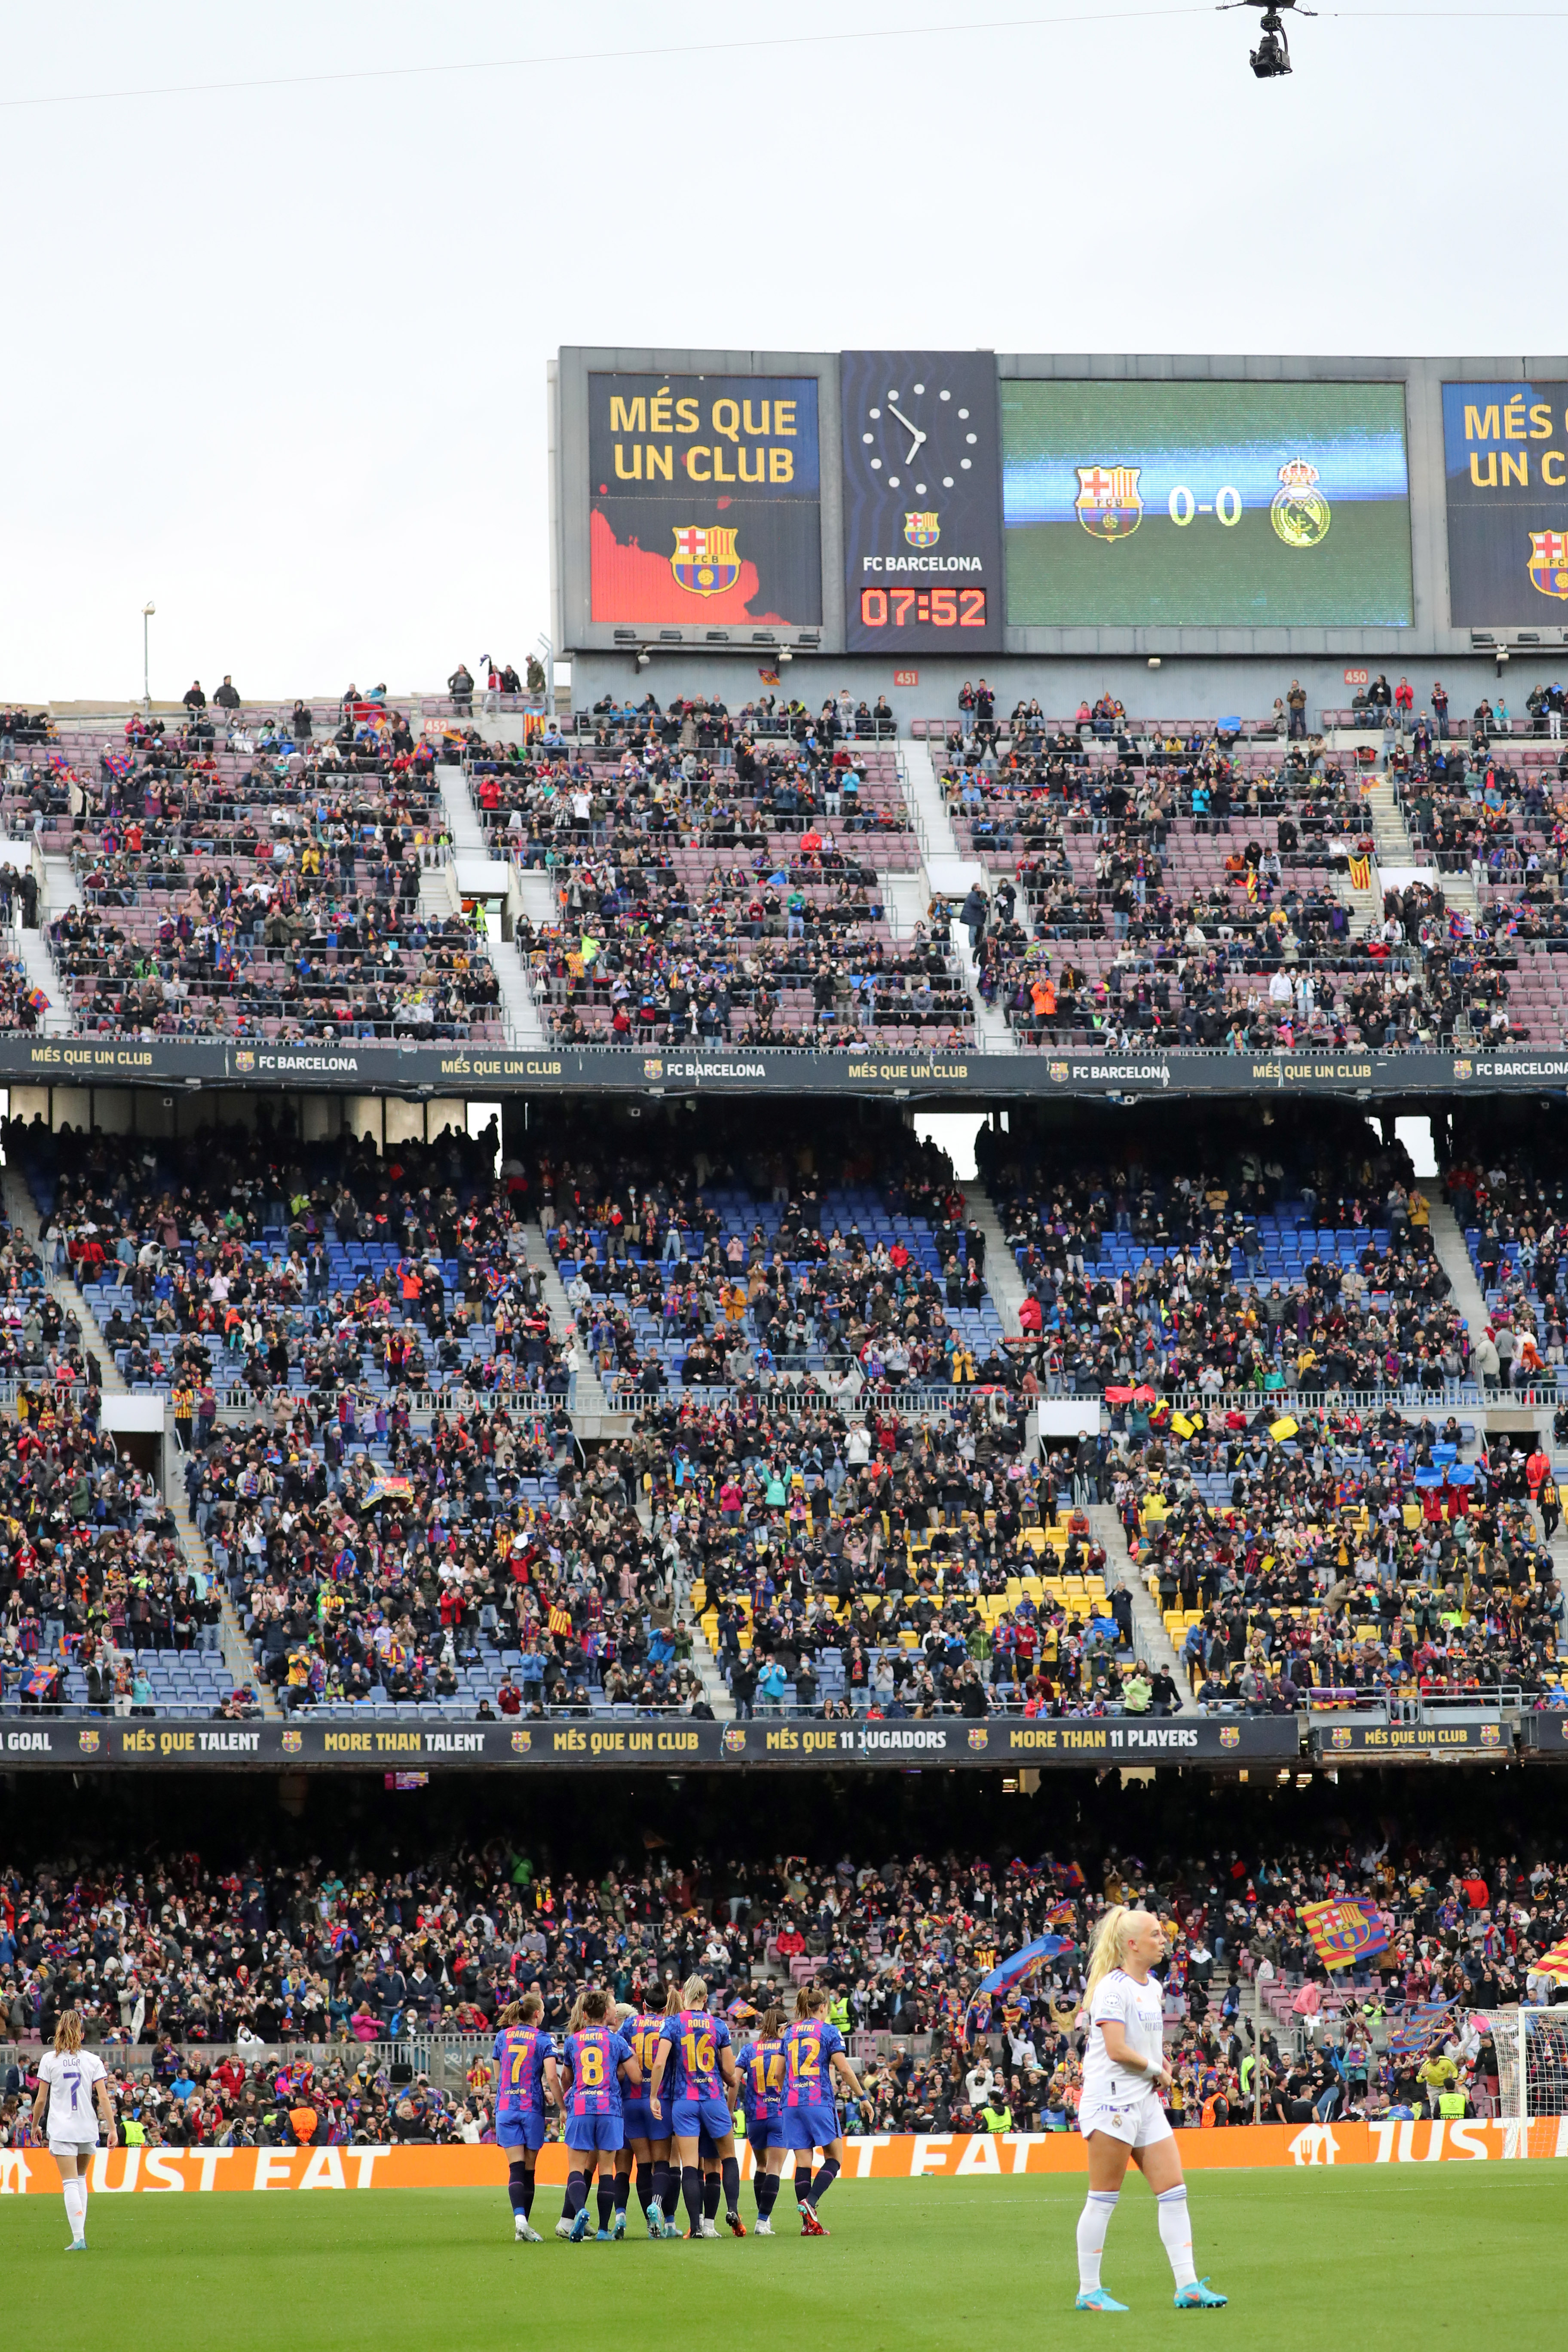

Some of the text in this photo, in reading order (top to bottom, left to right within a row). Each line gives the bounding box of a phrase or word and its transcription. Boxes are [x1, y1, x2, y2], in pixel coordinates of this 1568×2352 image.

[610, 386, 797, 442] MÉS QUE
[1464, 393, 1553, 439] MÉS
[614, 444, 794, 483] UN CLUB
[1470, 451, 1528, 487] UN
[1169, 486, 1242, 527] 0-0
[692, 555, 719, 564] FCB
[863, 556, 983, 571] FC BARCELONA
[861, 588, 986, 627] 07:52
[897, 672, 916, 684] 451
[1346, 671, 1367, 683] 450
[426, 720, 447, 732] 452
[31, 1046, 152, 1065] MÉS QUE UN CLUB
[259, 1056, 358, 1071] FC BARCELONA
[441, 1058, 561, 1075] MÉS QUE UN CLUB
[667, 1063, 766, 1076] FC BARCELONA
[848, 1062, 968, 1080] MÉS QUE UN CLUB
[1072, 1066, 1170, 1079] FC BARCELONA
[1253, 1063, 1372, 1080] MÉS QUE UN CLUB
[1476, 1063, 1492, 1075] FC
[8, 1732, 52, 1751] GOAL
[123, 1729, 260, 1755] MÉS QUE TALENT
[325, 1733, 485, 1752] MORE THAN TALENT
[554, 1729, 698, 1755] MÉS QUE UN CLUB
[766, 1728, 946, 1754] MÉS QUE 11 JUGADORS
[1010, 1729, 1198, 1748] MORE THAN 11 PLAYERS
[1365, 1728, 1467, 1747] MÉS QUE UN CLUB
[1335, 1922, 1354, 1932] FCB
[688, 2018, 710, 2029] ROLFÖ
[506, 2030, 535, 2040] GRAHAM
[579, 2032, 603, 2041] MARTA
[631, 2032, 660, 2071] 10
[680, 2033, 715, 2072] 16
[787, 2037, 821, 2077] 12
[63, 2058, 80, 2067] OLGA
[508, 2044, 528, 2083] 7
[580, 2046, 604, 2086] 8
[750, 2055, 782, 2093] 14
[63, 2071, 81, 2111] 7
[1368, 2116, 1535, 2162] JUST
[910, 2132, 1046, 2175] EAT
[92, 2145, 391, 2193] UST EAT
